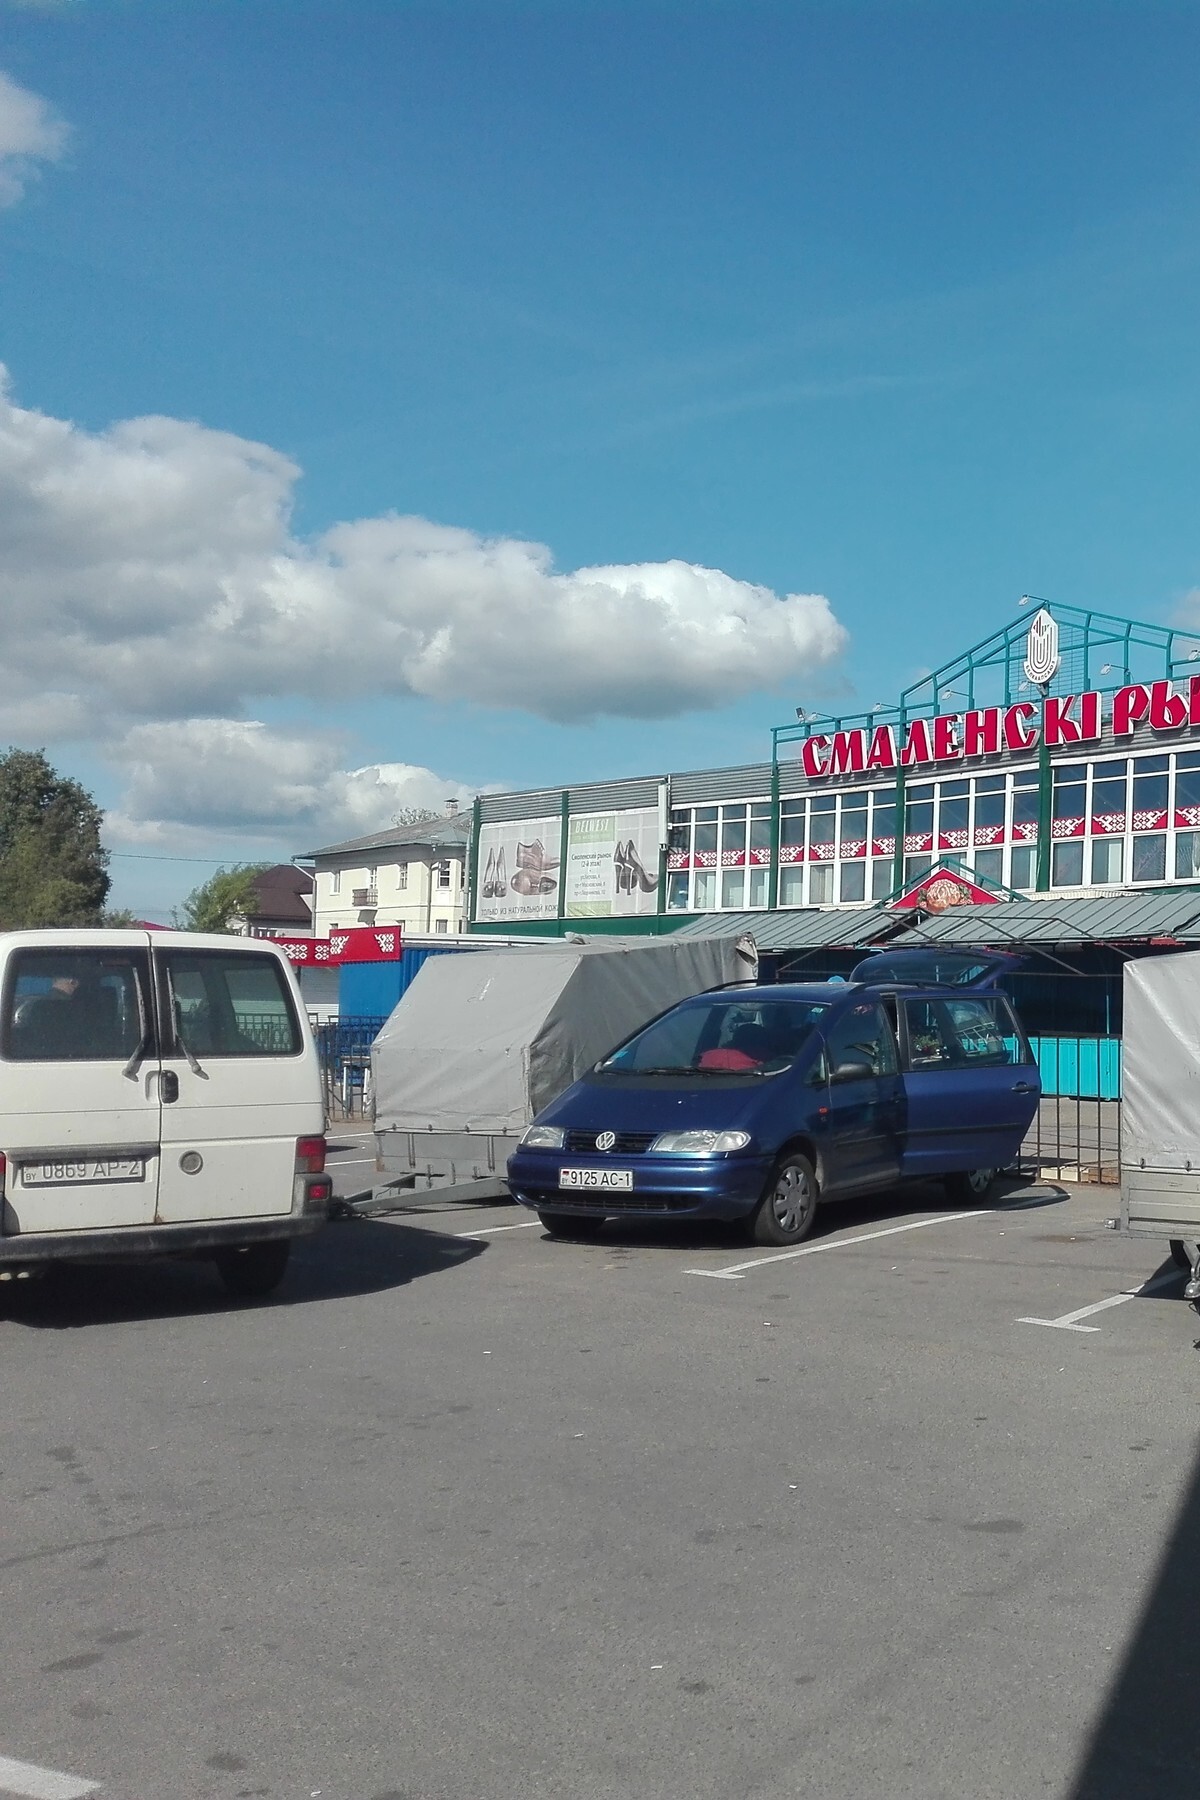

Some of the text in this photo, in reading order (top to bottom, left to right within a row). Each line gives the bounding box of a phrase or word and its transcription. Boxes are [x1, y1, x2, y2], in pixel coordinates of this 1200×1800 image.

[802, 689, 1103, 778] СМАЛЕНСКІ
[575, 818, 609, 834] BELWEST
[481, 907, 498, 916] ТОЛЬКО
[500, 907, 507, 915] ИЗ
[508, 904, 543, 915] НАТУРАЛЬНОЙ
[26, 1160, 139, 1182] BY 0869 AP-2
[570, 1171, 598, 1185] 9125
[600, 1172, 630, 1187] AC-1
